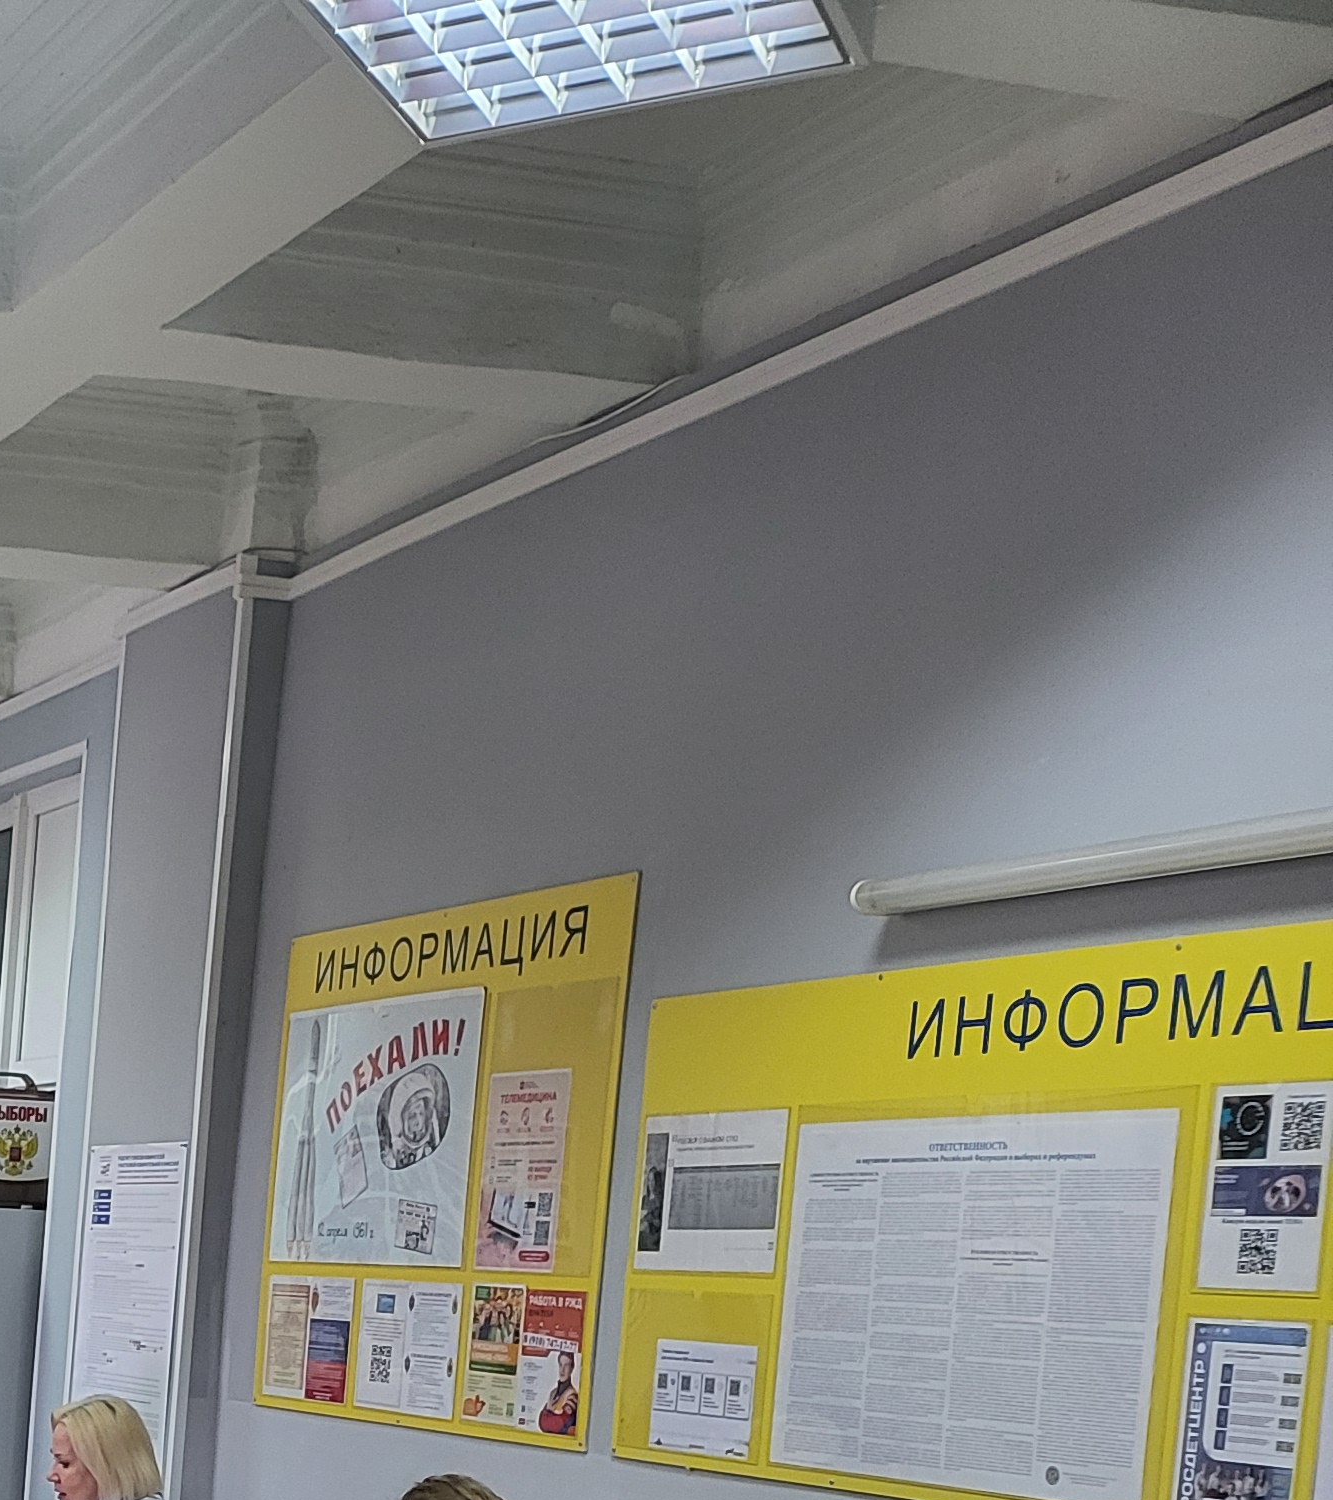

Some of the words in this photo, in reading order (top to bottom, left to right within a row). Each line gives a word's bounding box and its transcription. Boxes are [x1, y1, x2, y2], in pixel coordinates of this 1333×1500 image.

[315, 905, 589, 993] ИНФОРМАЦИЯ
[325, 1018, 466, 1134] ПОЕХАЛИ!
[928, 1141, 1008, 1152] ОТВЕТСТВЕННОСТЬ
[529, 1295, 557, 1308] РАБОТА
